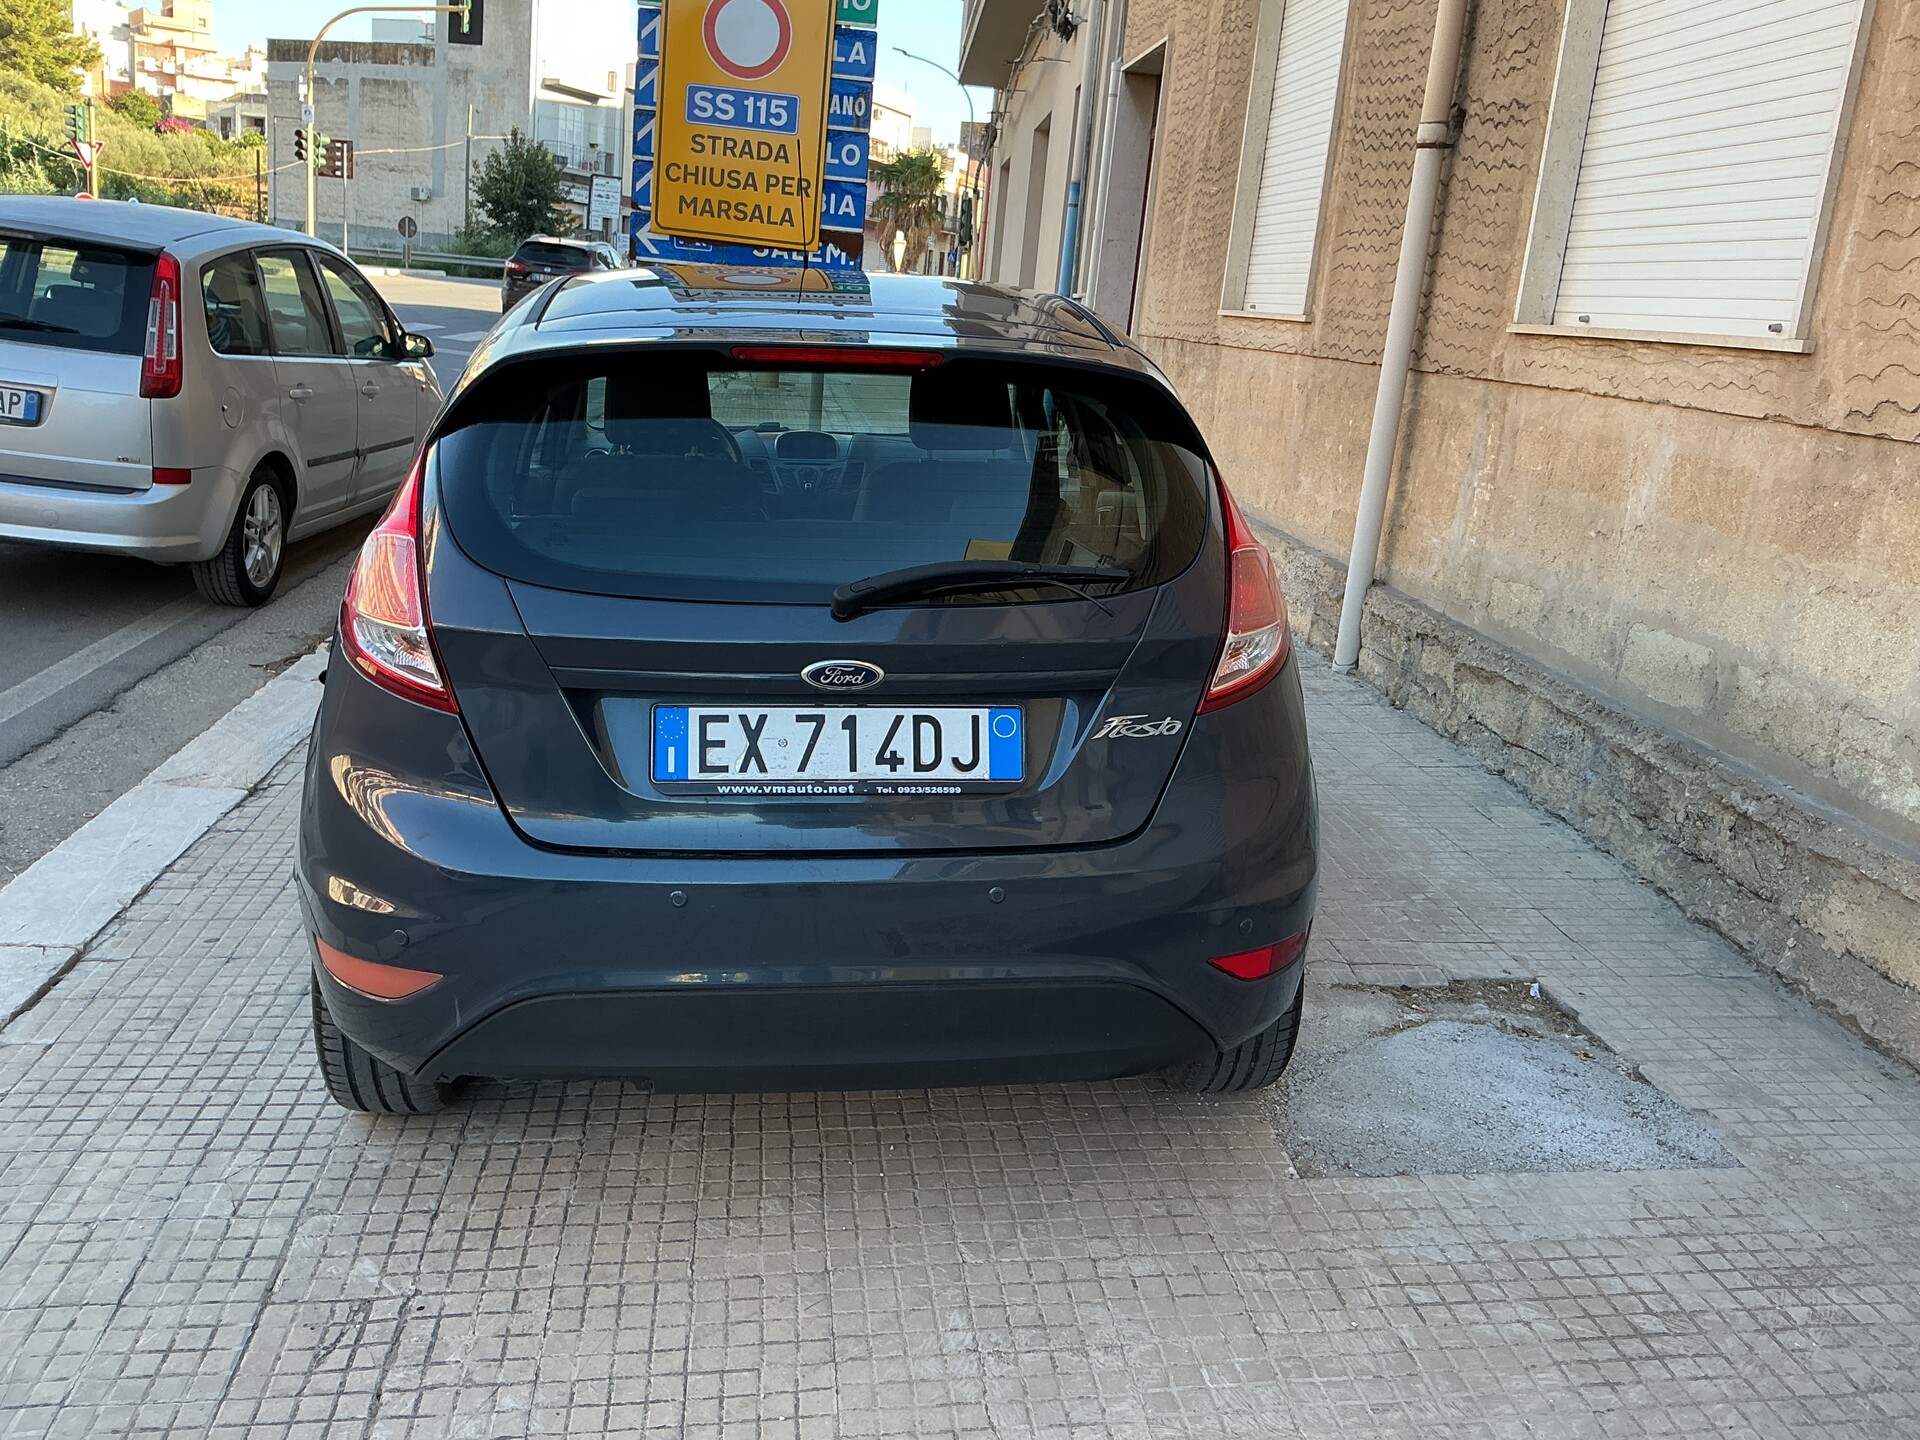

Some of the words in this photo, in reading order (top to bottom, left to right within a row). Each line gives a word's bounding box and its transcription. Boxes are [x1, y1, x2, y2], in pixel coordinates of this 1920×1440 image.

[692, 91, 736, 121] SS
[744, 96, 788, 127] 115
[690, 133, 790, 164] STRADA
[665, 162, 758, 192] CHIUSA
[766, 175, 812, 198] PER
[678, 195, 795, 228] MARSALA
[820, 666, 866, 684] Ford
[1091, 714, 1182, 739] Fiesta
[699, 714, 768, 773] EX
[795, 714, 980, 773] 714DJ
[716, 784, 855, 794] www.vmauto.net
[876, 786, 895, 794] Tel.
[897, 786, 962, 794] 0923/526599
